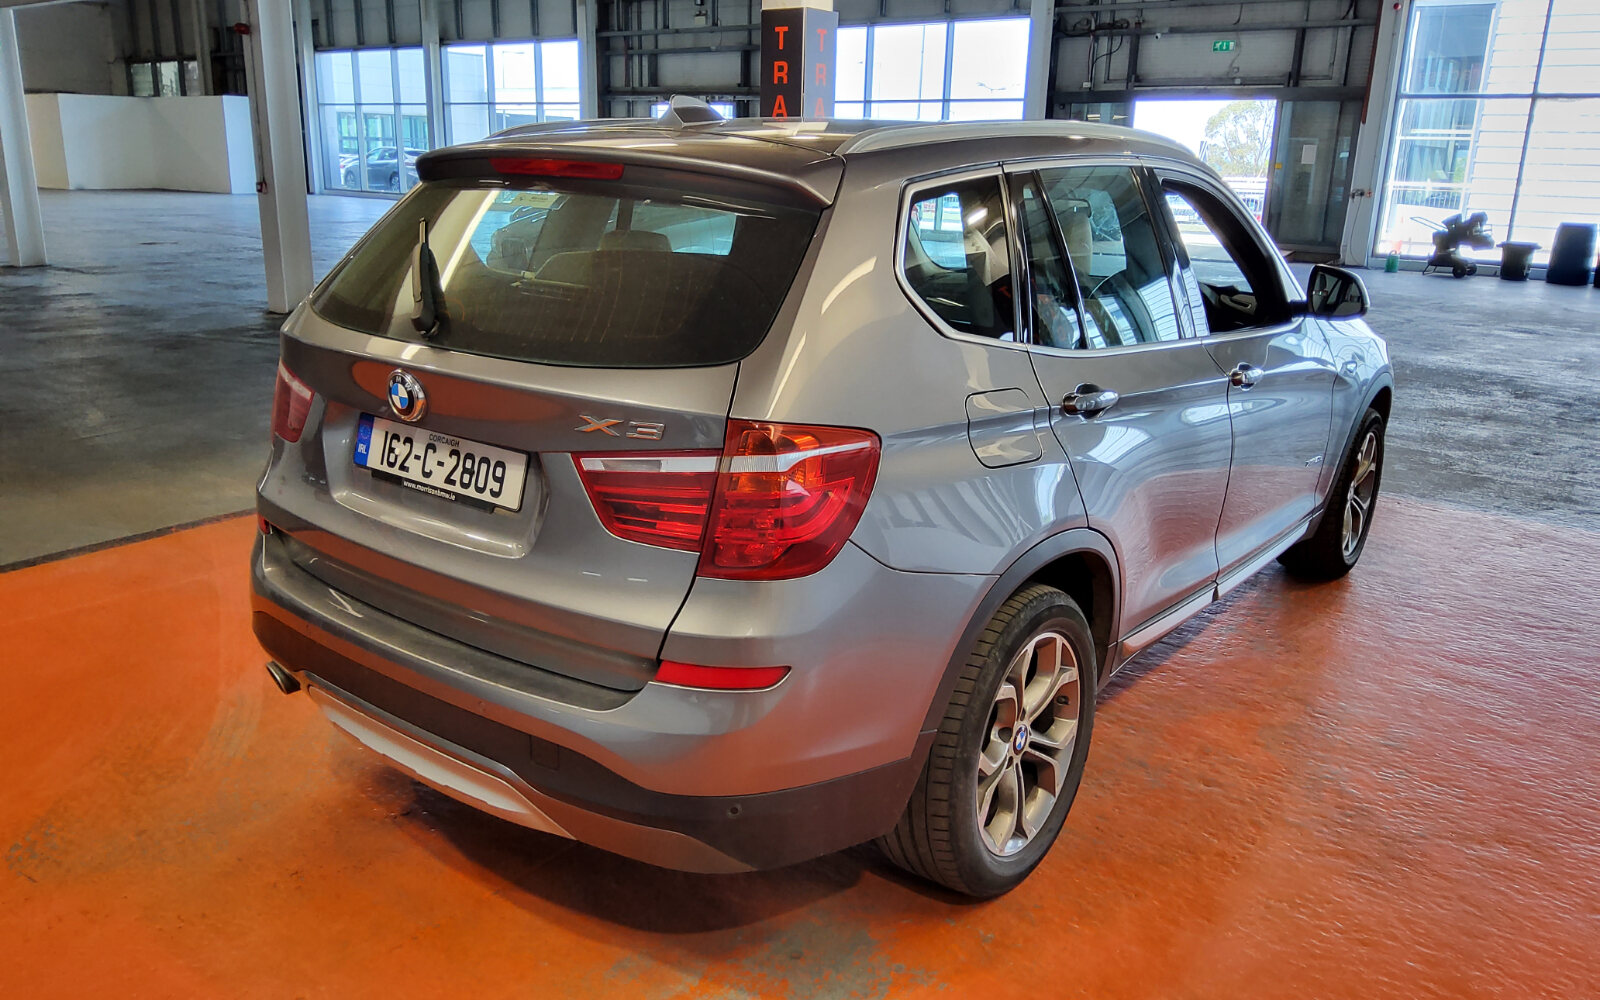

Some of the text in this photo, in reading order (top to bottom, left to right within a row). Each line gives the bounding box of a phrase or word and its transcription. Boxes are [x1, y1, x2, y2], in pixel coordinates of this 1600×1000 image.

[574, 415, 666, 440] X3
[357, 443, 367, 454] IRL
[429, 433, 460, 448] CORCAIGH
[380, 430, 507, 499] 162-C-2809
